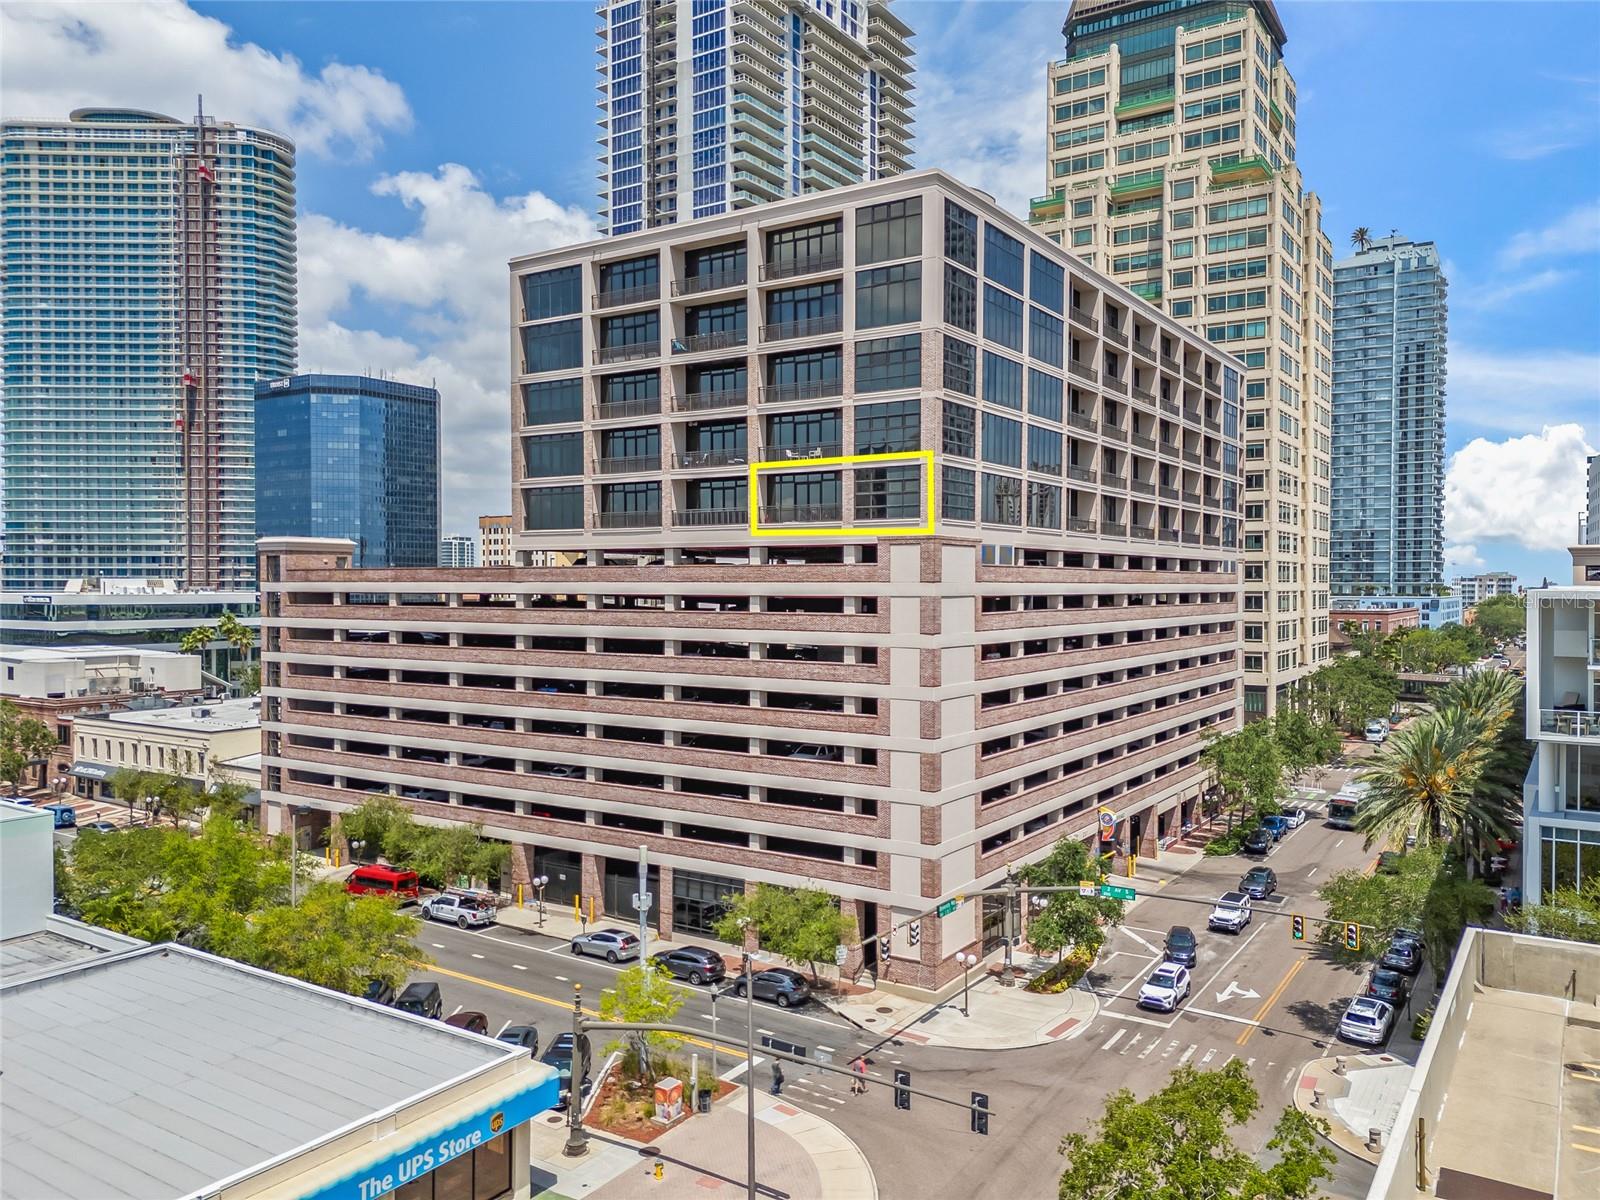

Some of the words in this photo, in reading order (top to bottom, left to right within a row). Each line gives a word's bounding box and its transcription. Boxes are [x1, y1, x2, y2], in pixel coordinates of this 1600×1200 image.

[1384, 247, 1432, 263] ASCENT
[358, 1174, 393, 1200] The
[398, 1148, 434, 1182] UPS
[439, 1130, 482, 1162] Store
